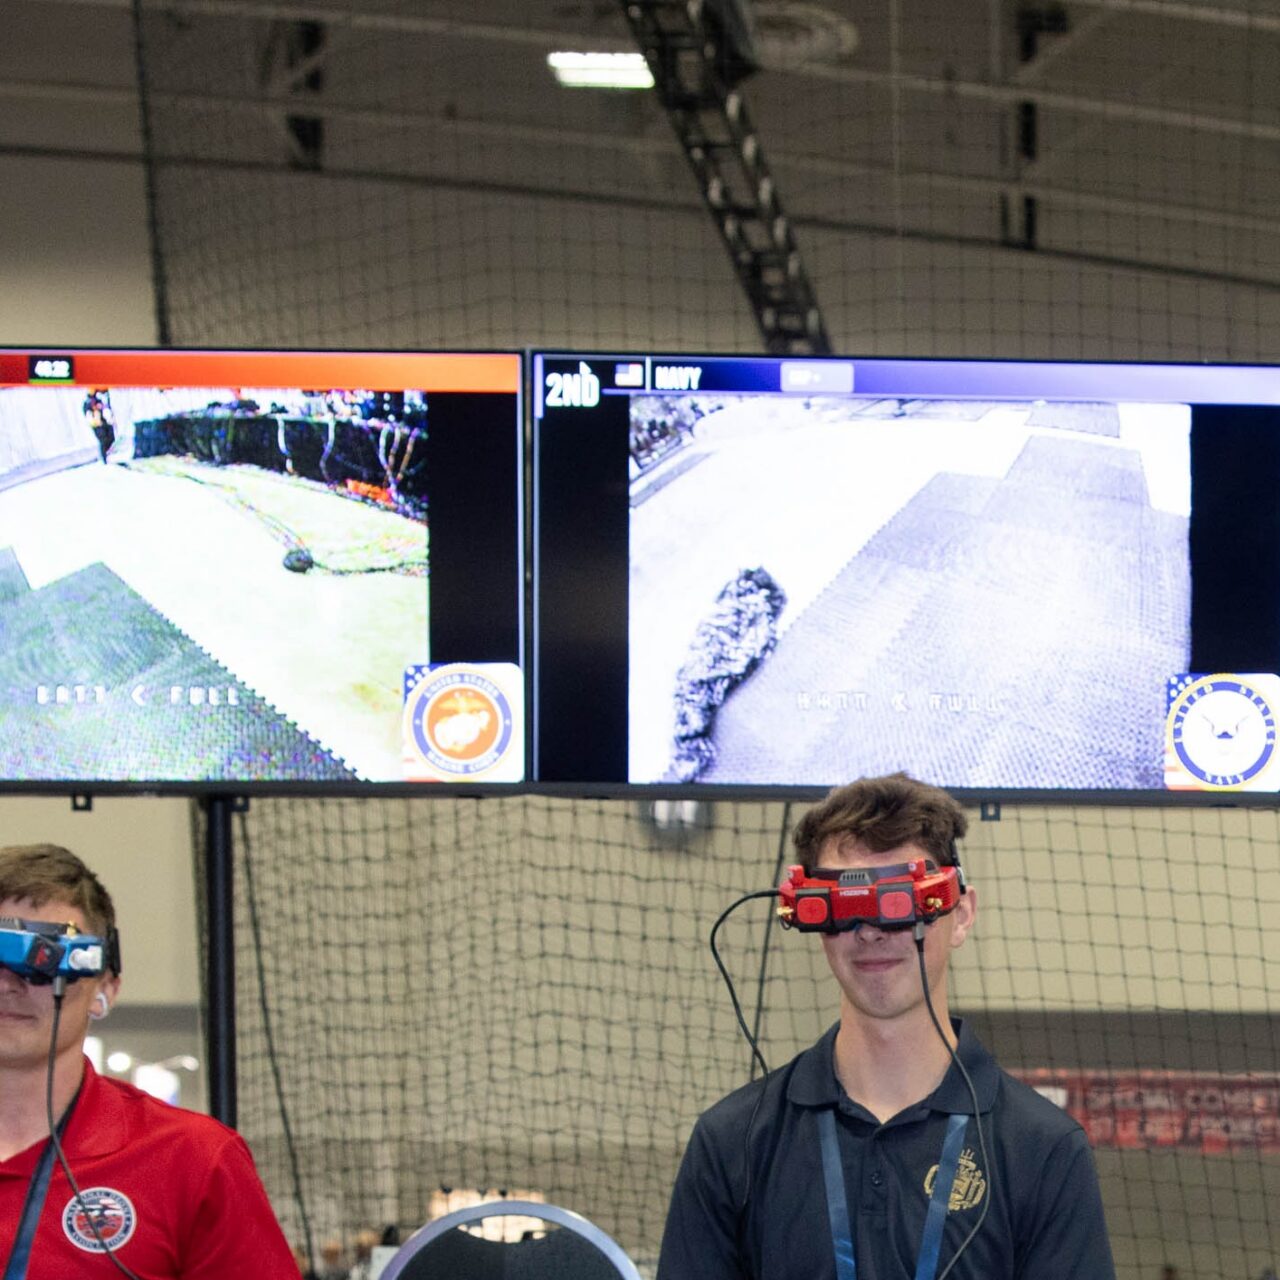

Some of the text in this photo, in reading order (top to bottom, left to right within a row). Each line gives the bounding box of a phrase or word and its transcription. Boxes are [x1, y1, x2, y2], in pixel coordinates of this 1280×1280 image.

[545, 366, 702, 407] 2ND NAVY
[1204, 772, 1245, 786] NAVY
